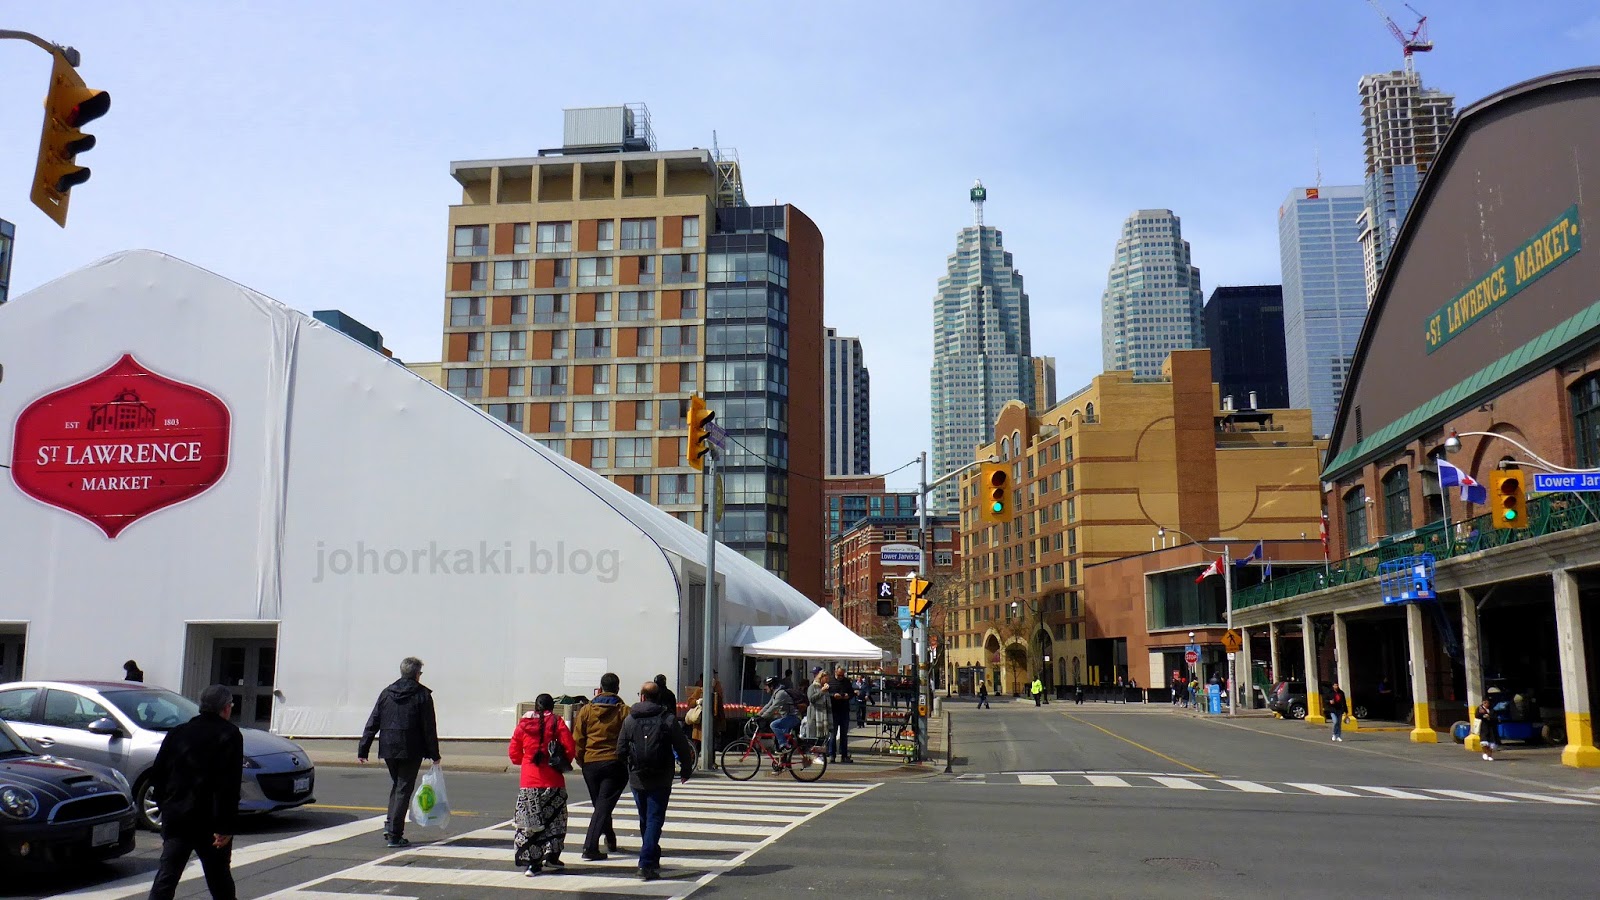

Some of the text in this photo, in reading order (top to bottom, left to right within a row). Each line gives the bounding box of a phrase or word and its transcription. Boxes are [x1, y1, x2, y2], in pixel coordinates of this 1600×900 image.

[1447, 266, 1507, 334] LAWRENCE
[1514, 218, 1570, 285] MARKET
[64, 421, 80, 429] EST
[164, 418, 180, 427] 1803
[65, 442, 203, 466] LAWRENCE
[81, 476, 152, 491] MARKET
[1538, 475, 1576, 487] Lower
[881, 552, 898, 560] Lower
[898, 552, 914, 560] Jarvis
